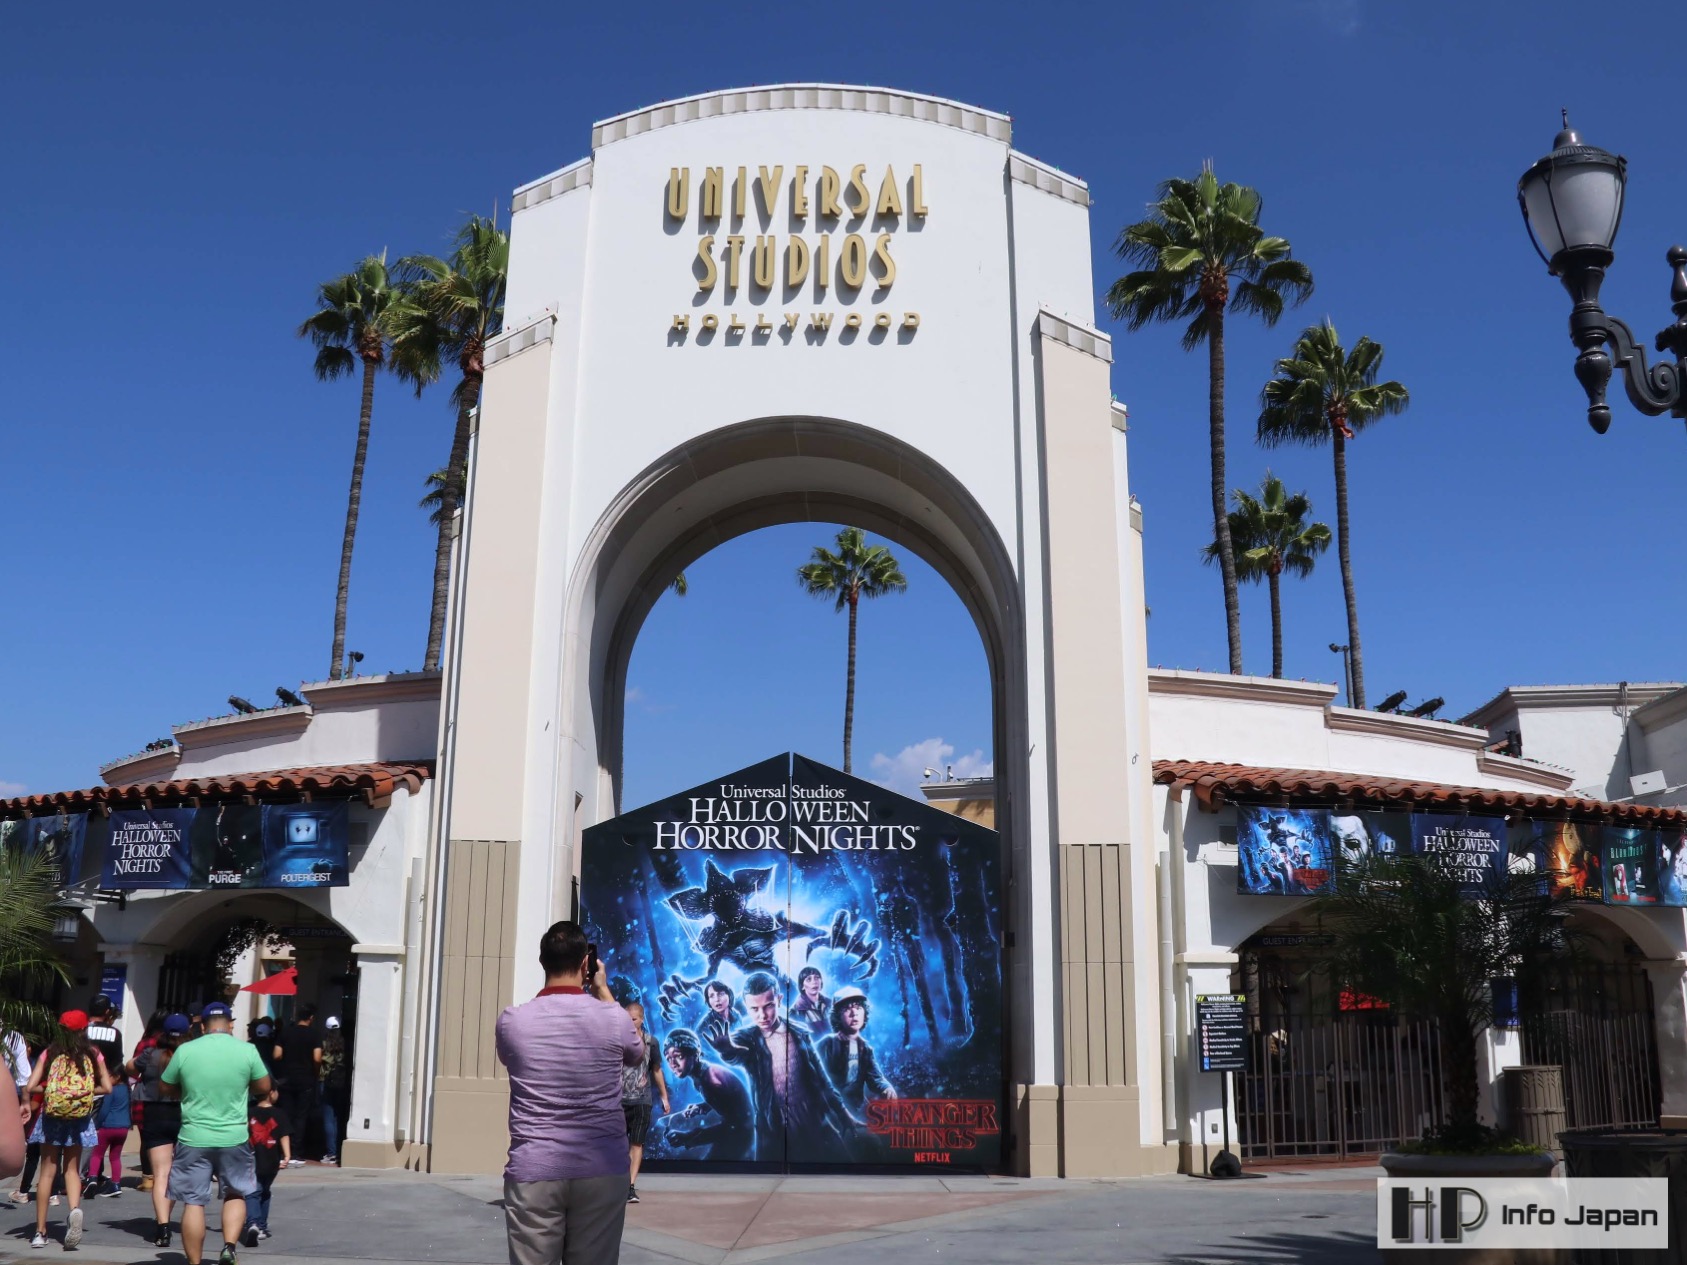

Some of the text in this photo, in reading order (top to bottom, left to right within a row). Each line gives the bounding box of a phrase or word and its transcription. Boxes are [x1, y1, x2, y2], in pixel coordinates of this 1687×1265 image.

[668, 163, 929, 219] UNIVERSAL
[697, 232, 897, 291] STUDIOS
[673, 312, 921, 332] HOLLYWOOD
[720, 784, 846, 799] Universal Studios
[688, 797, 871, 824] HALLOWEEN
[123, 820, 151, 831] Universal
[1435, 826, 1466, 838] Unvsal
[111, 829, 182, 846] HALLOWEEN
[652, 821, 786, 850] HORROR
[1423, 835, 1500, 852] HALLOWEEN
[121, 843, 172, 860] HORROR
[208, 874, 242, 884] PURGE
[280, 872, 332, 883] POLTERGEIST
[1440, 867, 1484, 883] NHTS
[1206, 995, 1235, 1003] WARNING
[866, 1098, 1000, 1135] STRANGER
[889, 1126, 976, 1149] THINGS
[914, 1152, 951, 1163] NETFLIX
